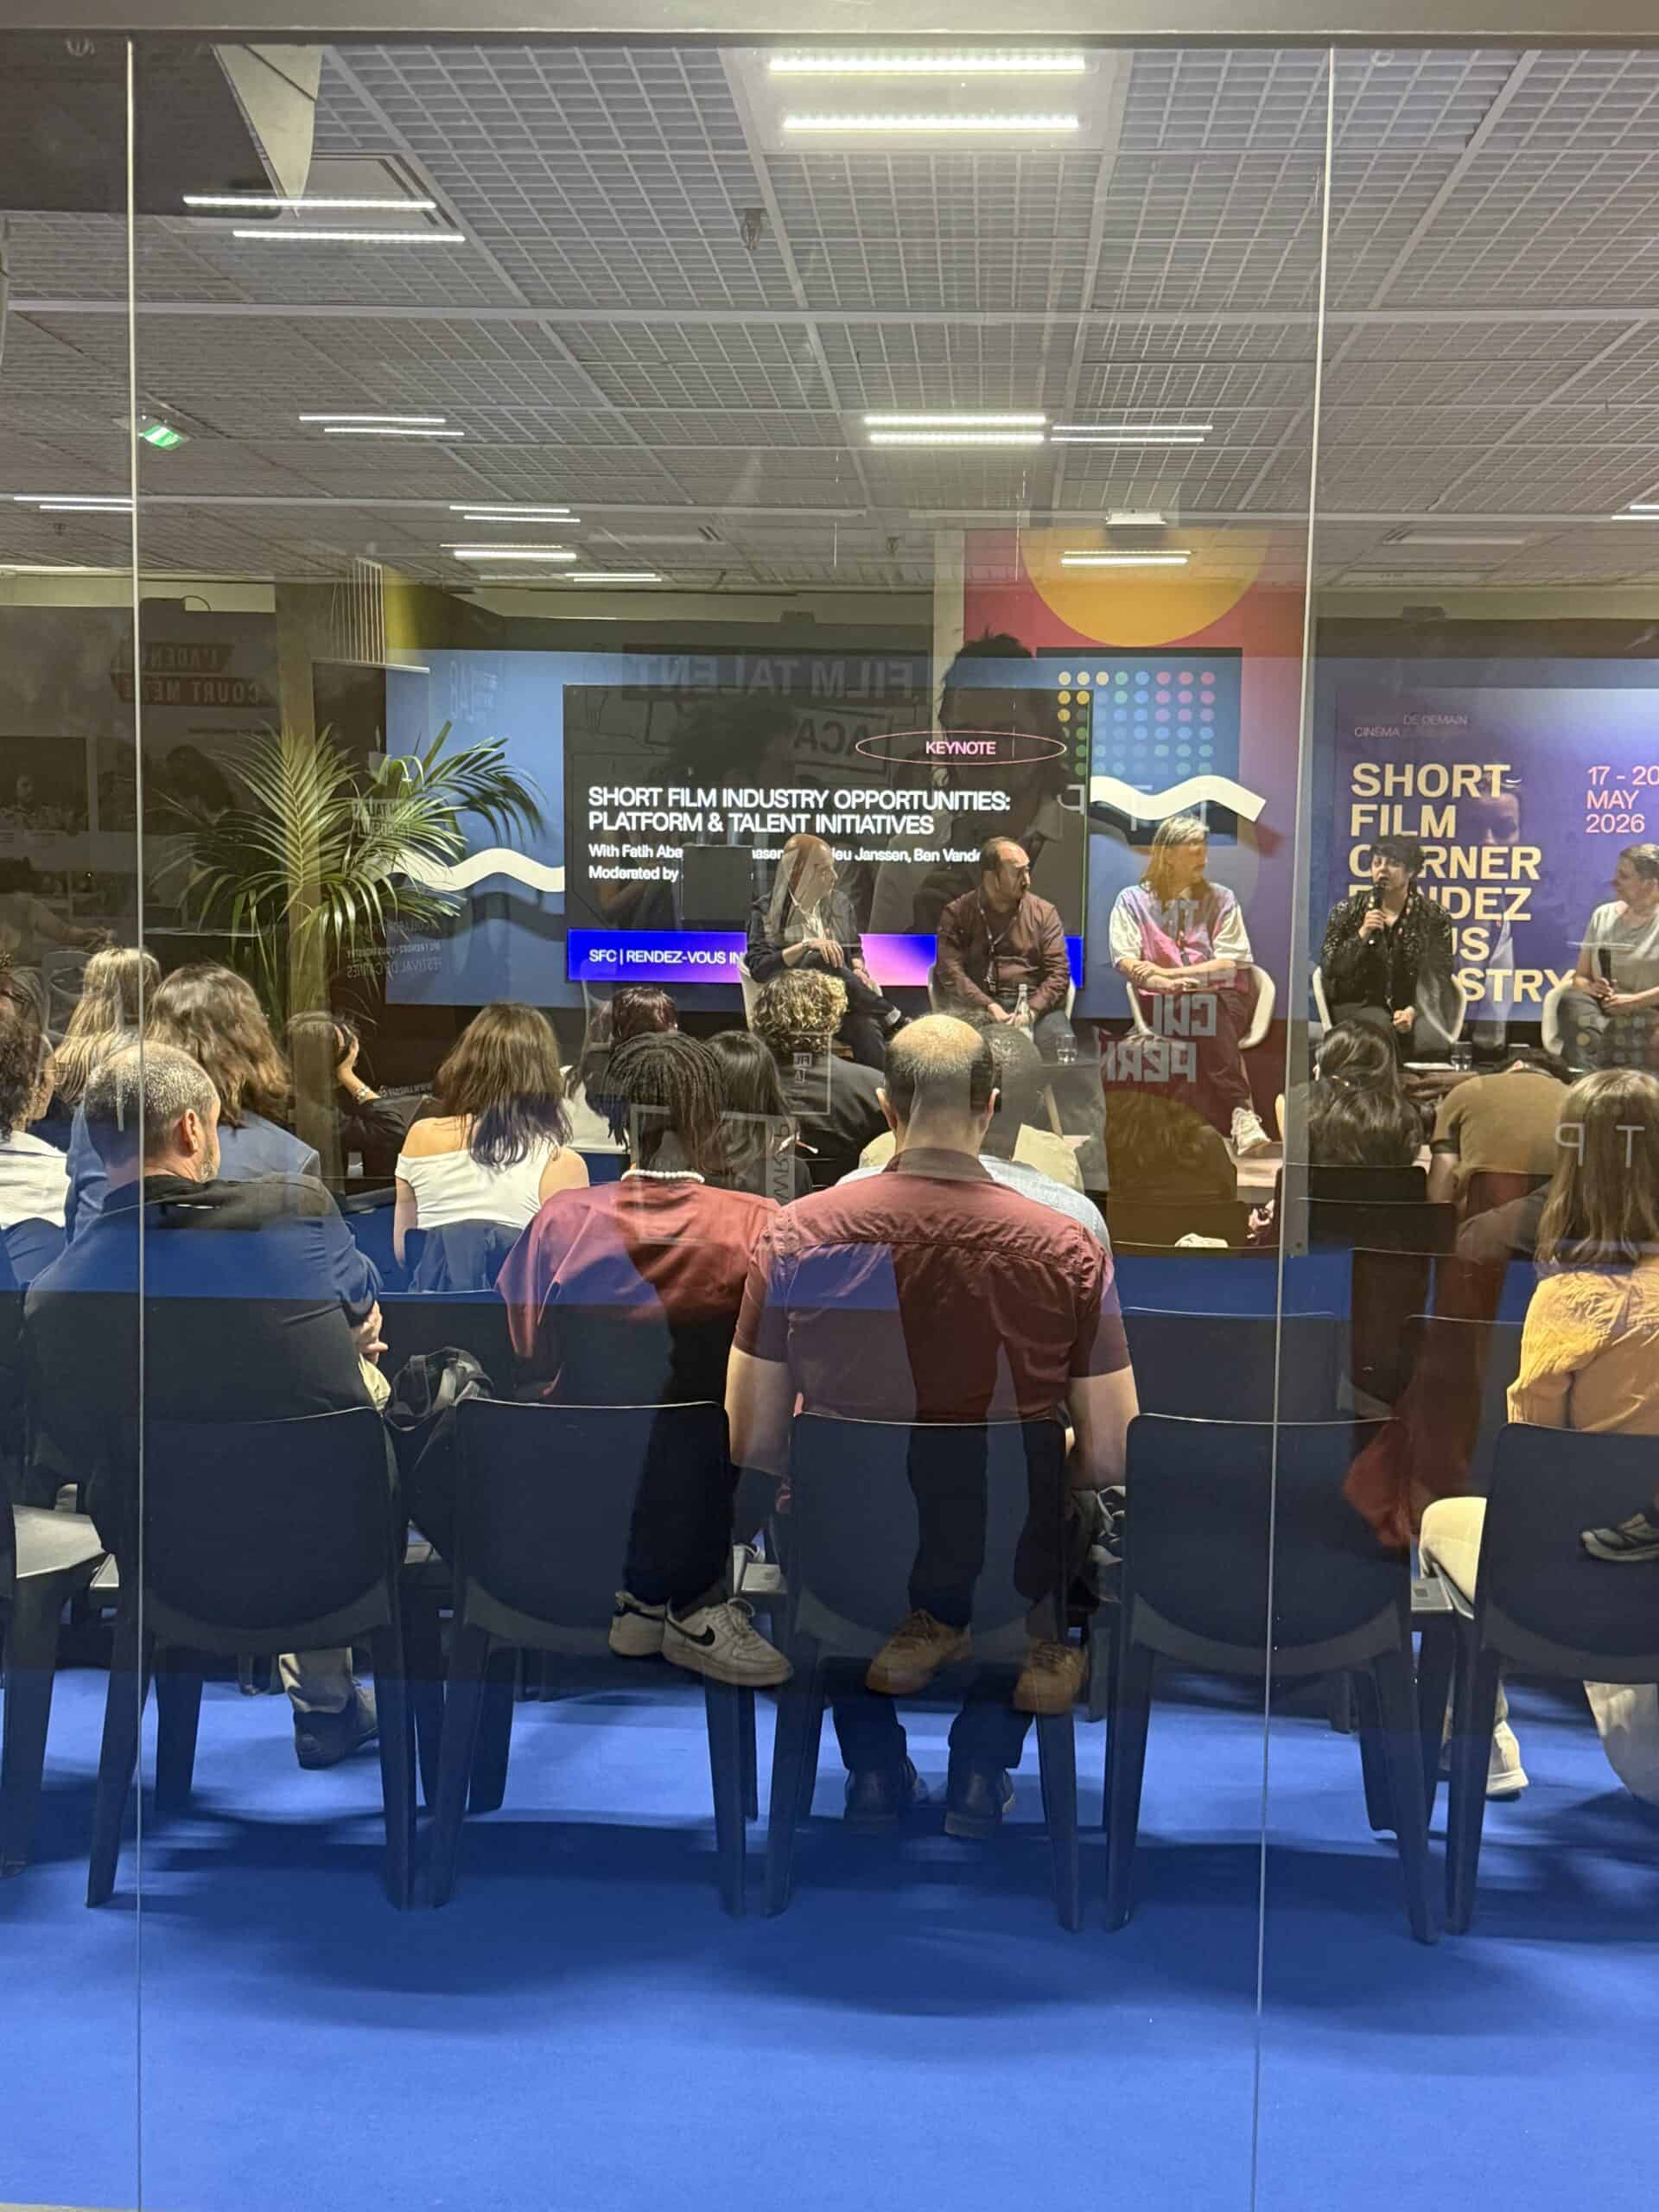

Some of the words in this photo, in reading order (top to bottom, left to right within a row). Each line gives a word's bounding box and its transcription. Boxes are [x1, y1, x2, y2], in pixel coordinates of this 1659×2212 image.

[925, 741, 995, 755] KEYNOTE
[1351, 763, 1510, 798] SHORT
[1588, 766, 1611, 785] 17
[1632, 766, 1659, 786] 20
[588, 786, 663, 807] SHORT
[669, 788, 716, 808] FILM
[723, 788, 828, 809] INDUSTRY
[834, 790, 1010, 810] OPPORTUNITIES:
[1586, 790, 1639, 810] MAY
[588, 811, 702, 831] PLATFORM
[708, 813, 723, 832] &
[728, 813, 810, 833] TALENT
[816, 815, 934, 835] INITIATIVES
[1351, 804, 1457, 838] FILM
[1586, 813, 1645, 833] 2026
[588, 843, 620, 859] With
[622, 843, 653, 859] Fatih
[657, 844, 683, 859] Abe
[855, 848, 912, 863] Janssen,
[914, 848, 939, 861] Ben
[1349, 844, 1541, 880] CRNER
[588, 865, 659, 880] Moderated
[663, 867, 678, 882] by
[589, 950, 616, 962] SFC
[626, 950, 727, 963] RENDEZ-VOUS
